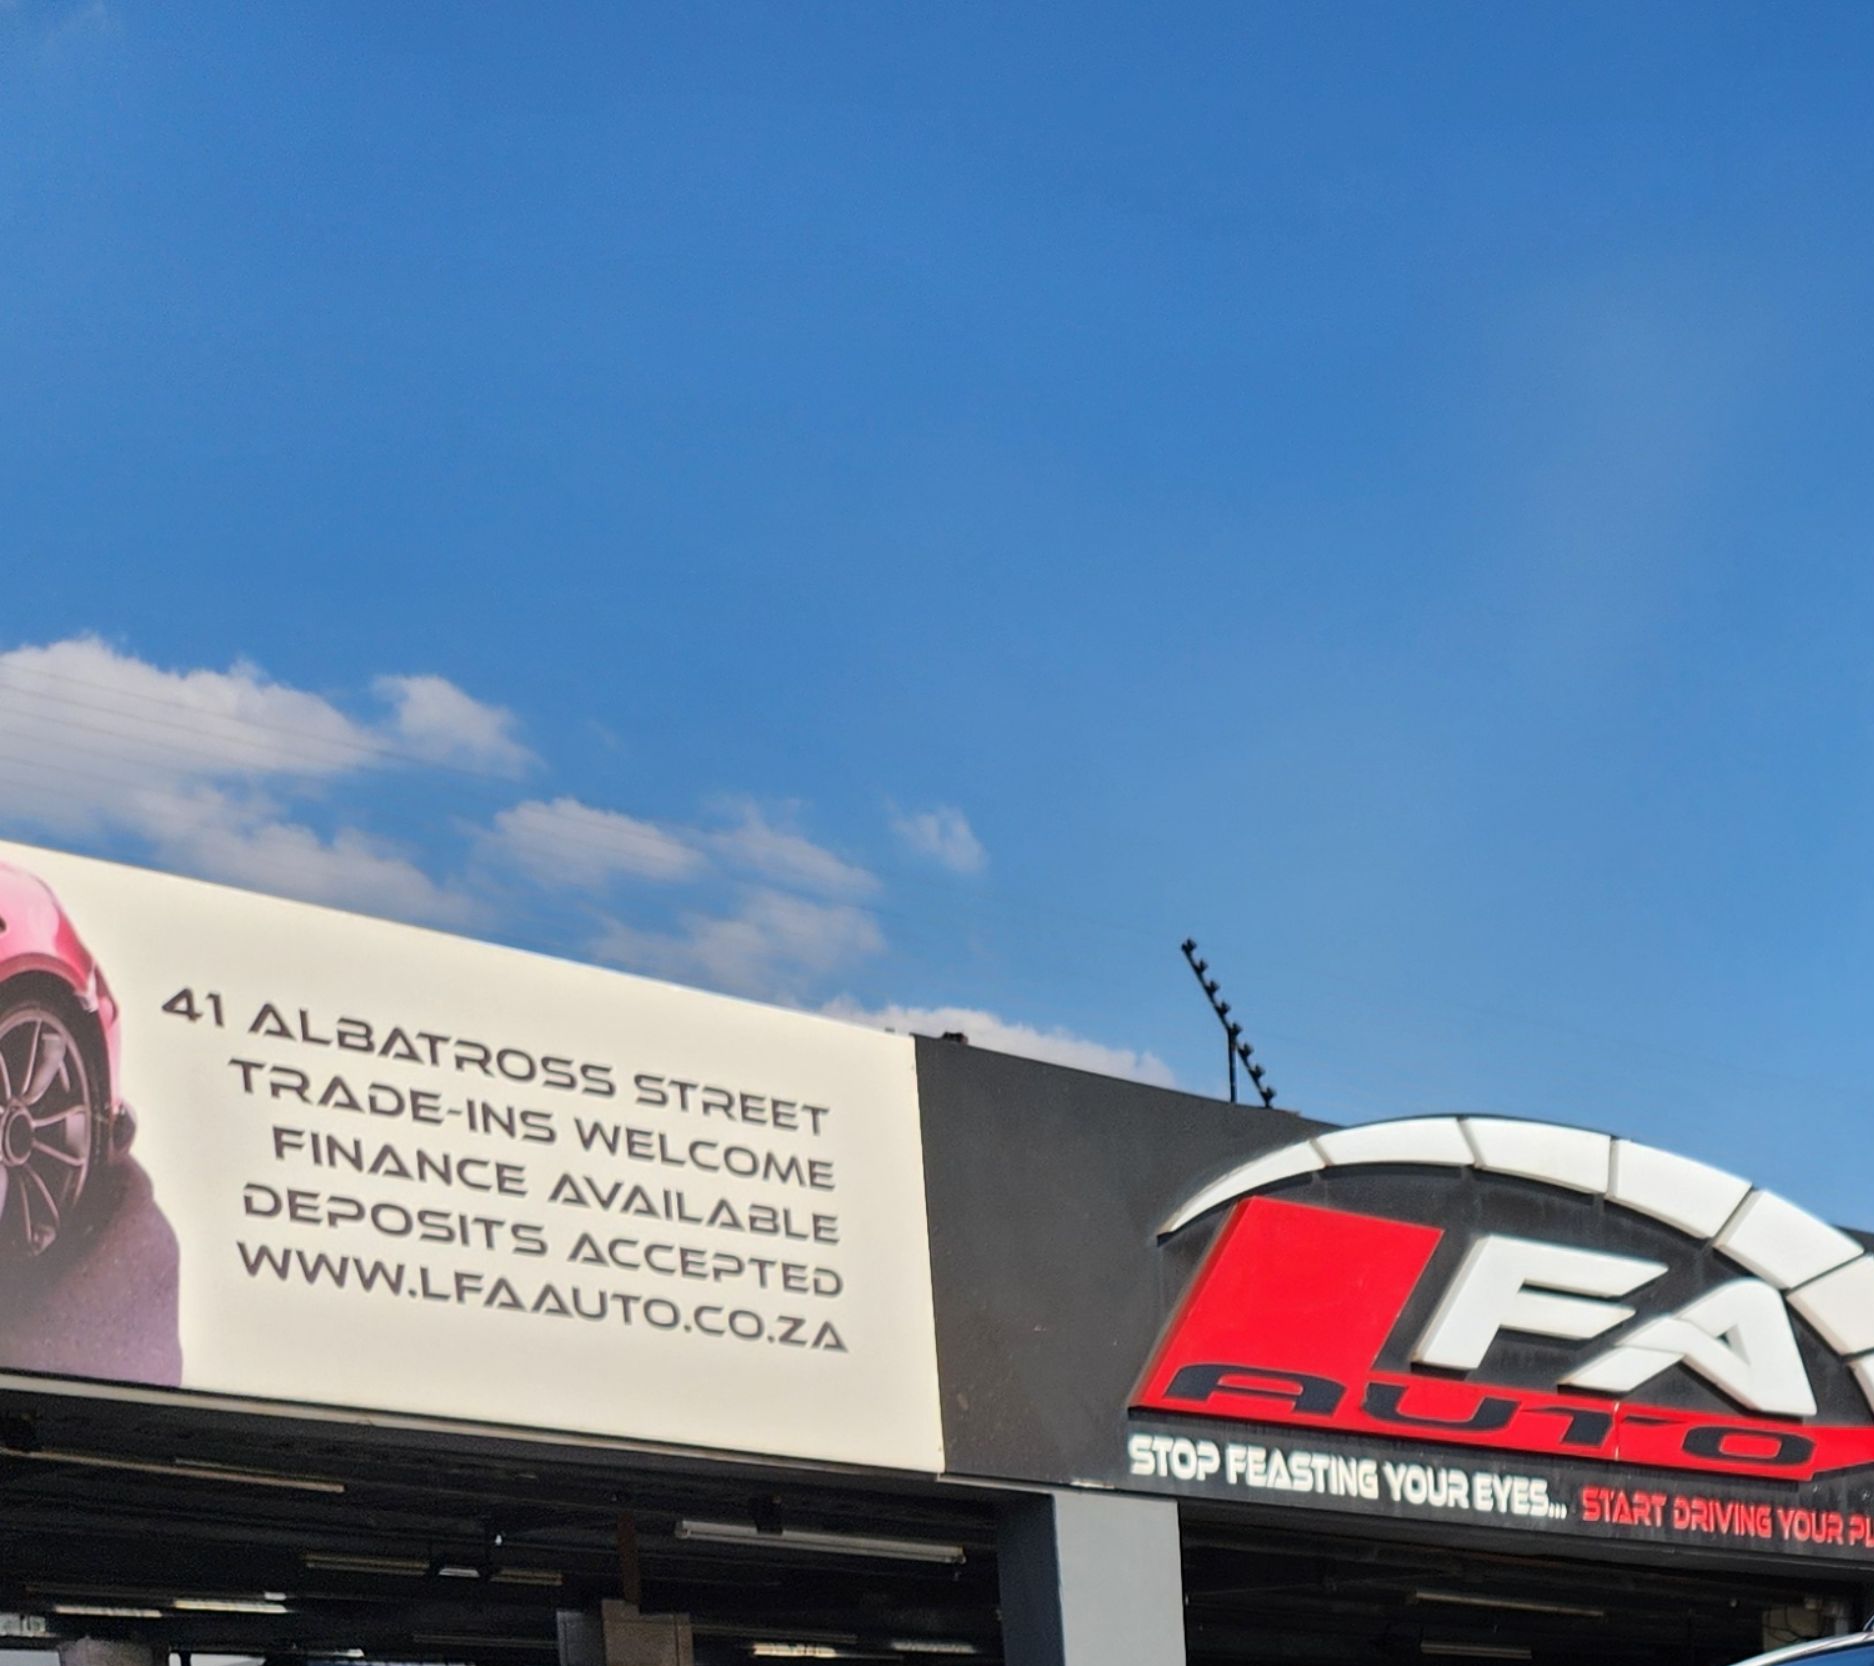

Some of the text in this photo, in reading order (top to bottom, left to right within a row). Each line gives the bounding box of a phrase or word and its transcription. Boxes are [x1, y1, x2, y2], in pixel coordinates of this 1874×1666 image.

[161, 988, 829, 1135] 41 ALBATROSS STREET
[229, 1058, 835, 1190] TRADE-INS WELCOME
[243, 1183, 843, 1297] DEPOSITS ACCEPTED
[272, 1126, 839, 1245] FINANCE AVAILABLE
[237, 1242, 848, 1353] WWW.LFAAUTO.CO.ZA
[1165, 1363, 1815, 1466] AUTO
[1128, 1433, 1220, 1481] STOP
[1225, 1441, 1380, 1500] FEASTING
[1382, 1460, 1470, 1510] YOUR
[1474, 1471, 1569, 1520] EYES...
[1582, 1485, 1666, 1528] START
[1673, 1496, 1772, 1539] DRIVING
[1776, 1507, 1845, 1545] YOUR
